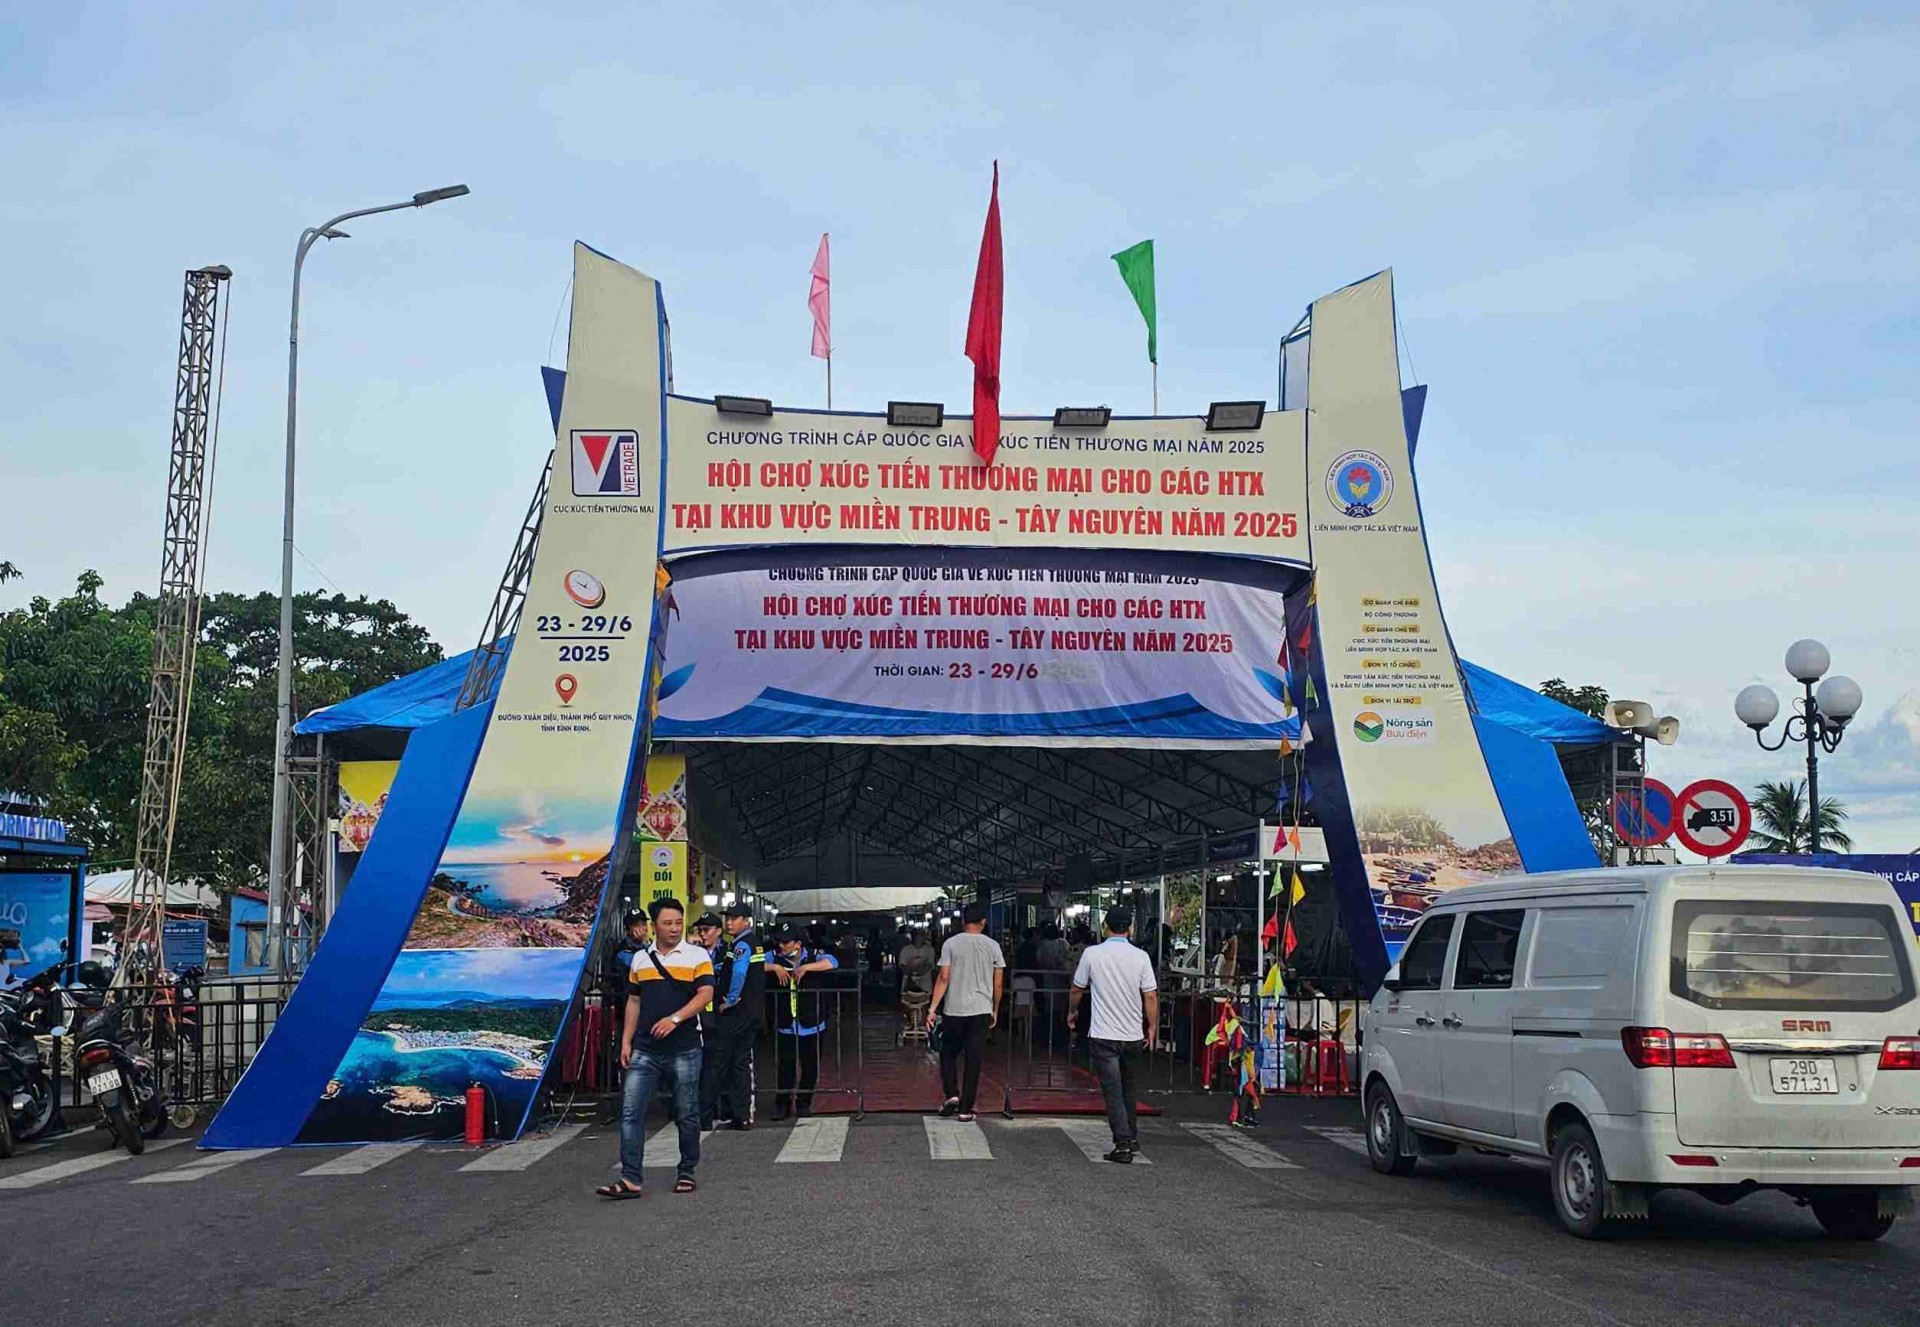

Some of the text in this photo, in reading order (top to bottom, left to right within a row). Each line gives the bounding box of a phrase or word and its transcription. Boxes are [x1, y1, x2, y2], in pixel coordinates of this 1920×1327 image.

[706, 431, 783, 445] CHƯƠNG
[788, 428, 838, 446] TRÌNH
[936, 434, 965, 448] GIA
[997, 432, 1029, 449] XÚC
[1075, 437, 1148, 452] THƯƠNG
[1153, 439, 1182, 456] MẠI
[1188, 436, 1223, 453] NĂM
[1228, 440, 1265, 454] 2025
[623, 443, 636, 493] VIETRADE
[708, 456, 1265, 498] HỘI CHỢ XÚC TIẾN THƯƠNG MẠI CHO CÁC HTX
[672, 503, 712, 534] TẠI
[721, 504, 771, 529] KHU
[780, 500, 831, 533] VỰC
[840, 496, 900, 530] MIỀN
[908, 505, 990, 532] TRUNG
[1015, 504, 1060, 533] TÂY
[1068, 506, 1162, 535] NGUYÊN
[1172, 507, 1225, 537] NĂM
[1234, 511, 1297, 538] 2025
[1364, 524, 1377, 532] TÁC
[942, 567, 964, 581] GIA
[763, 589, 1206, 621] HỘI CHỢ XÚC TIẾN THƯƠNG MẠI CHO CÁC HTX
[537, 616, 560, 632] 23
[582, 615, 632, 633] 29/6
[735, 630, 767, 653] TẠI
[774, 630, 815, 650] KHU
[822, 627, 863, 653] VỰC
[869, 622, 918, 650] MIỀN
[924, 630, 989, 650] TRUNG
[1009, 627, 1045, 651] TÂY
[1051, 628, 1127, 652] NGUYÊN
[1133, 629, 1176, 653] NĂM
[1182, 633, 1234, 654] 2025
[559, 645, 610, 662] 2025
[874, 664, 904, 677] THỜI
[908, 666, 944, 677] GIAN:
[949, 663, 972, 679] 23
[991, 663, 1039, 680] 29/6
[1710, 810, 1733, 823] 3.5T
[1782, 1020, 1832, 1032] SRM
[1789, 1060, 1817, 1075] 29D
[1780, 1077, 1830, 1091] 571.31
